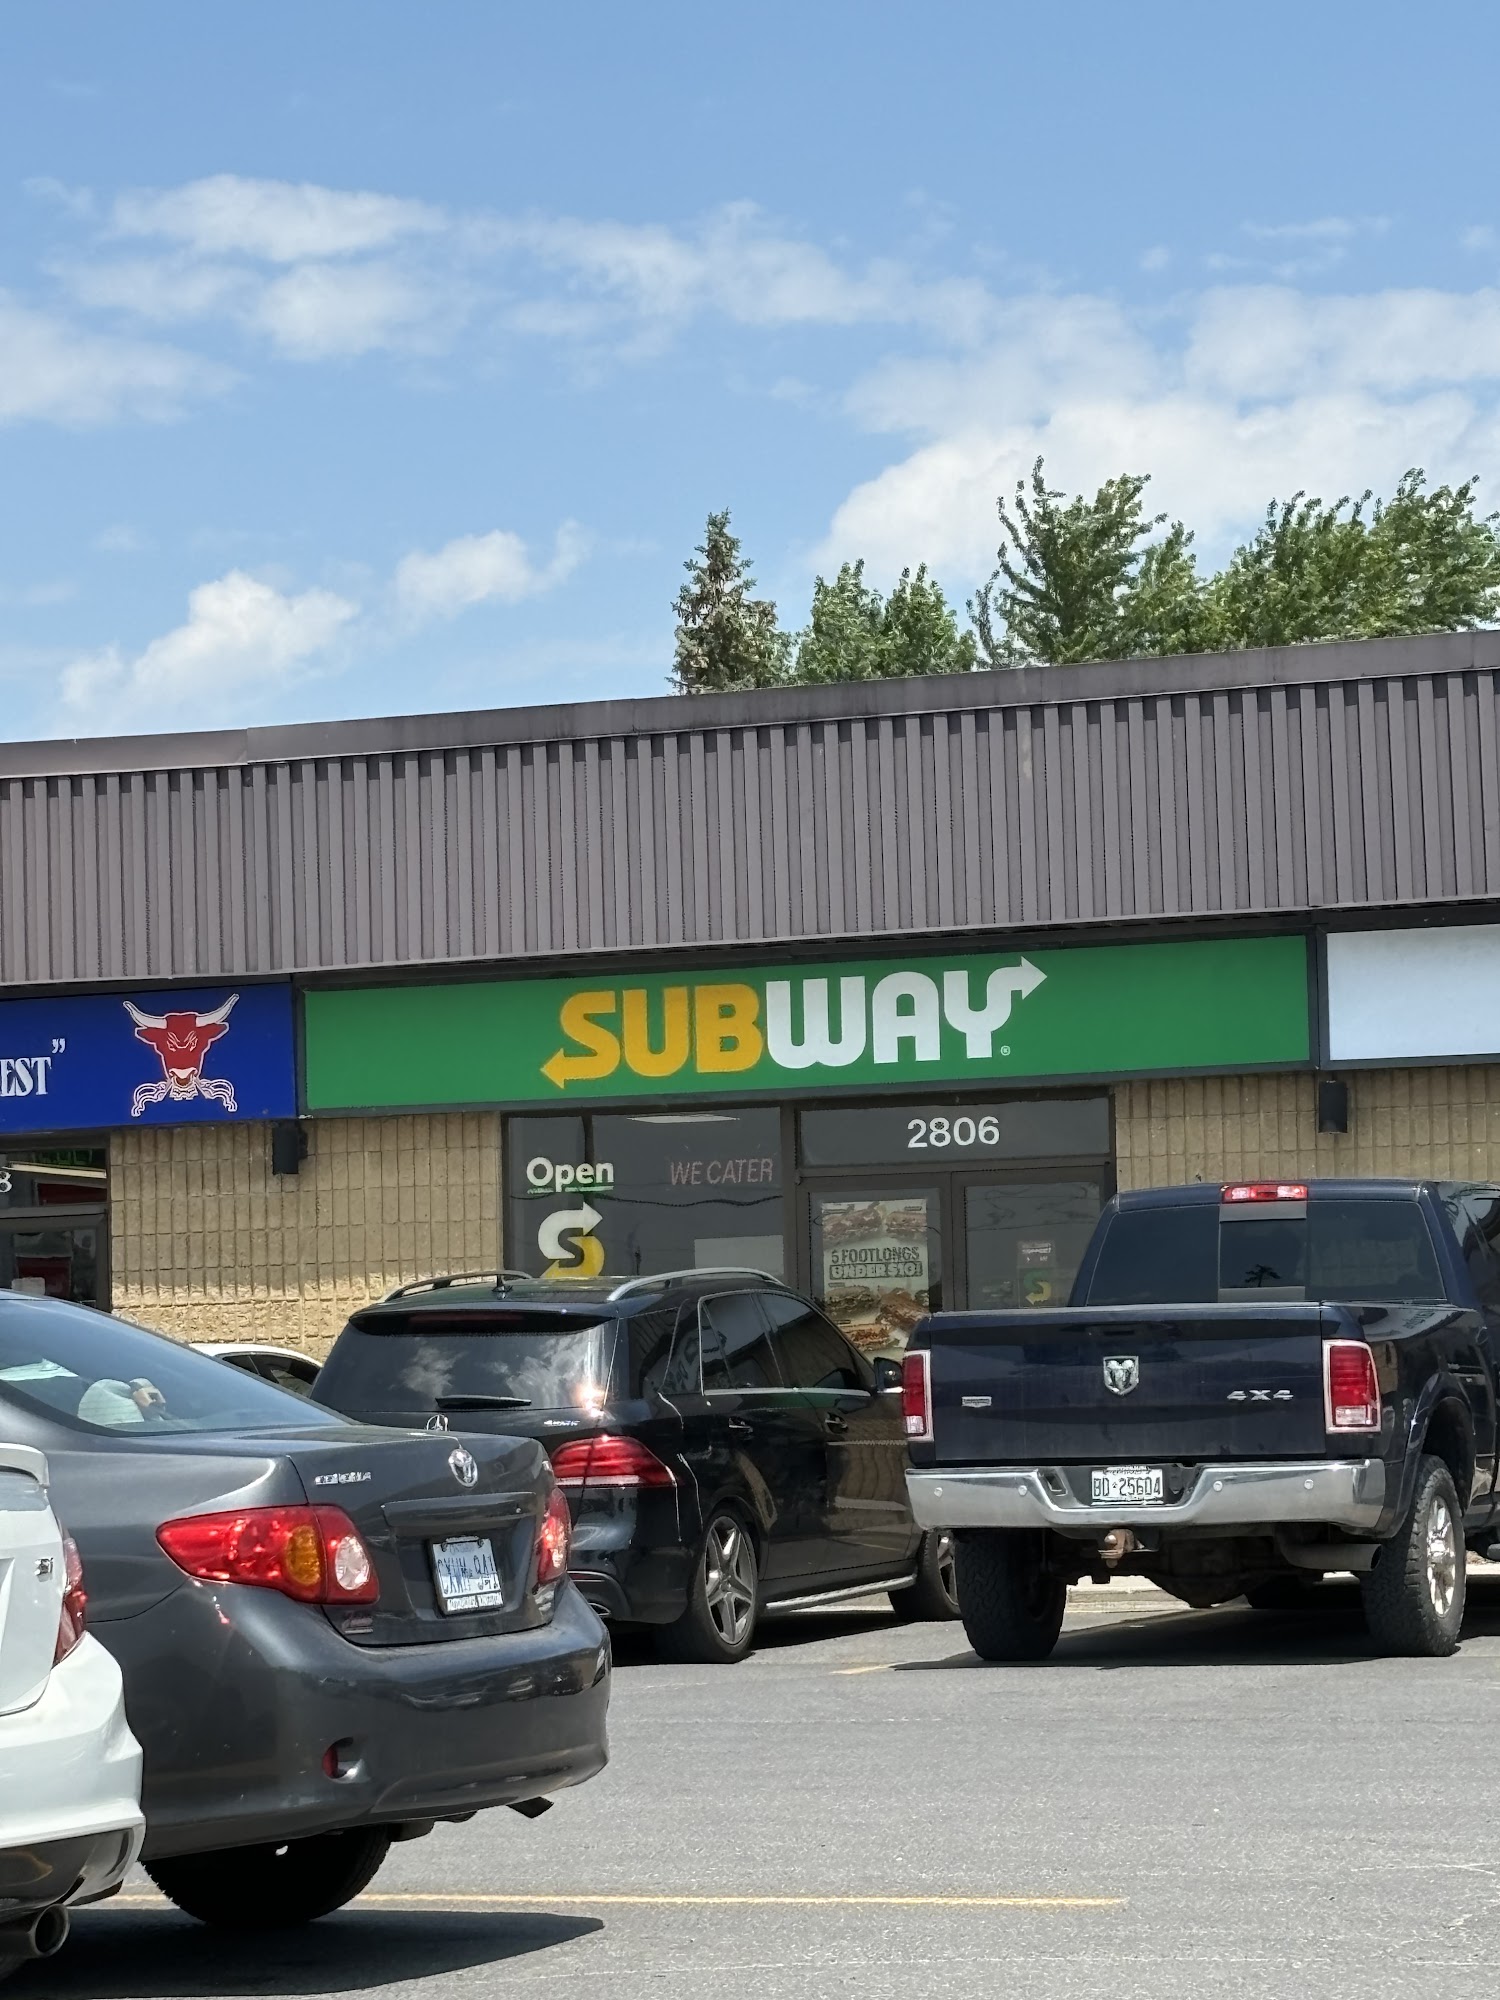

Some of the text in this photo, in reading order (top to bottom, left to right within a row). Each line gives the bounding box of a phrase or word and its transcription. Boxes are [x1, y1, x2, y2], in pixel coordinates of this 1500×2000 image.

[541, 957, 1048, 1089] SUBWAY
[907, 1116, 1000, 1148] 2806
[526, 1157, 614, 1192] Open
[671, 1158, 773, 1186] WE CATER
[841, 1246, 920, 1263] FOOTLONGS
